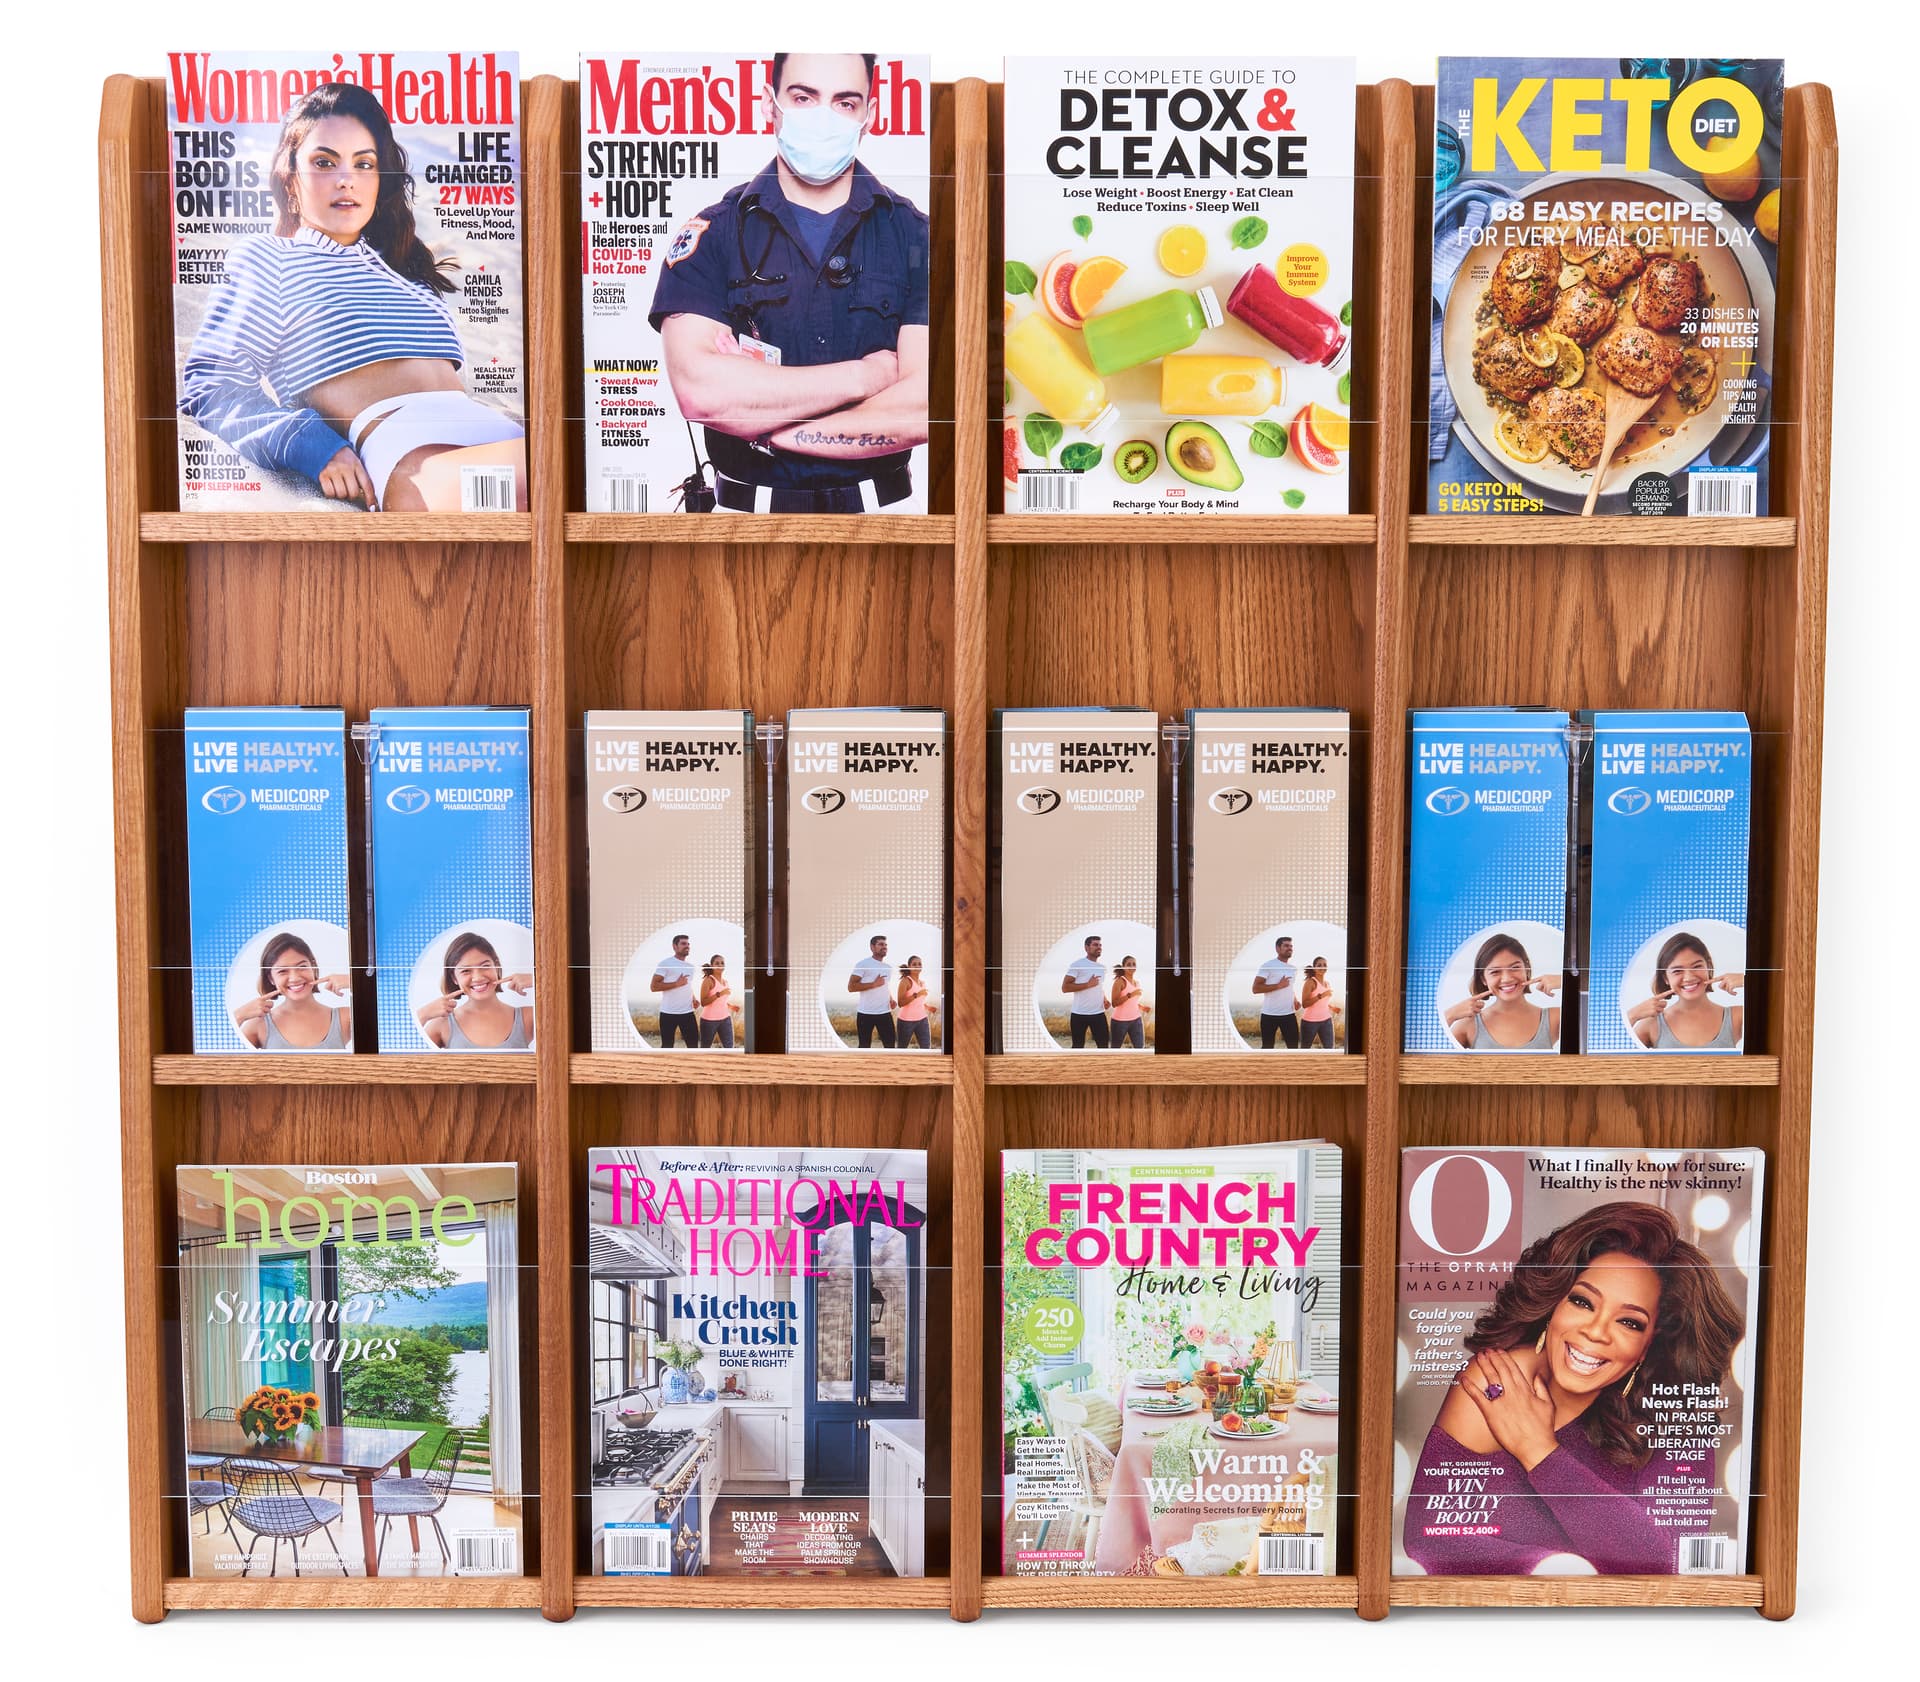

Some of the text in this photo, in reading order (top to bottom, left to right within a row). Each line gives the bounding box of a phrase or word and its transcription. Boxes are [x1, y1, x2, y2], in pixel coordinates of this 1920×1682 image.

[1064, 70, 1296, 84] THE COMPLETE GUIDE TO
[586, 60, 736, 136] Men's
[1060, 88, 1296, 132] DETOX &
[1458, 108, 1471, 138] THE
[1472, 77, 1764, 174] KETO
[1695, 118, 1736, 134] DIET
[174, 130, 235, 158] THIS
[458, 132, 514, 163] LIFE.
[588, 141, 718, 179] STRENGTH
[1046, 136, 1308, 180] CLEANSE
[176, 160, 260, 188] BOD IS
[425, 165, 515, 184] CHANGED.
[439, 186, 515, 205] 27 WAYS
[1063, 188, 1294, 202] Lose Weight Boost Energy Eat Clean
[177, 190, 274, 218] ON FIRE
[1490, 202, 1723, 222] 68 EASY RECIPES
[178, 223, 272, 234] SAME WORKOUT
[1458, 226, 1756, 247] FOR EVERY MEAL OF THE DAY
[592, 248, 651, 260] COVID-19
[592, 262, 647, 274] Hot Zone
[465, 274, 501, 286] CAMILA
[464, 286, 503, 297] MENDES
[1680, 322, 1759, 334] 20 MINUTES
[594, 360, 658, 372] WHAT NOW?
[601, 429, 641, 438] FITNESS
[601, 438, 650, 447] BLOWOUT
[193, 742, 340, 756] LIVE HEALTHY.
[379, 742, 524, 756] LIVE HEALTHY.
[595, 741, 742, 755] LIVE HEALTHY.
[794, 742, 940, 756] LIVE HEALTHY.
[1009, 742, 1156, 756] LIVE HEALTHY.
[1202, 743, 1348, 757] LIVE HEALTHY.
[1420, 743, 1563, 757] LIVE HEALTHY.
[1602, 744, 1746, 758] LIVE HEALTHY.
[193, 759, 318, 773] LIVE HAPPY.
[378, 759, 502, 773] LIVE HAPPY.
[595, 758, 720, 772] LIVE HAPPY.
[794, 759, 918, 773] LIVE HAPPY.
[1009, 759, 1134, 773] LIVE HAPPY.
[1202, 760, 1325, 773] LIVE HAPPY.
[1419, 760, 1542, 774] LIVE HAPPY.
[1602, 760, 1724, 774] LIVE HAPPY.
[251, 788, 329, 803] MEDICORP
[435, 788, 513, 803] MEDICORP
[652, 788, 731, 802] MEDICORP
[850, 789, 929, 803] MEDICORP
[1066, 789, 1144, 804] MEDICORP
[1258, 789, 1336, 804] MEDICORP
[1474, 789, 1552, 803] MEDICORP
[1656, 789, 1734, 803] MEDICORP
[1528, 1158, 1746, 1175] What I finally know for sure:
[306, 1171, 378, 1185] Boston
[1540, 1176, 1742, 1193] Healthy is the new skinny!
[596, 1164, 922, 1228] TRADITIONAL
[1049, 1182, 1296, 1224] FRENCH
[212, 1172, 477, 1249] home
[1408, 1154, 1512, 1256] O
[690, 1228, 830, 1277] HOME
[1024, 1227, 1321, 1270] COUNTRY
[1408, 1261, 1513, 1272] THE OPRAH
[1117, 1256, 1325, 1313] Home & Living
[207, 1290, 385, 1324] Summer
[672, 1294, 798, 1320] Kitchen
[1034, 1308, 1074, 1328] 250
[698, 1320, 799, 1346] Crush
[238, 1328, 401, 1373] Escapes
[719, 1349, 794, 1358] BLUE & WHITE
[719, 1359, 787, 1368] DONE RIGHT!
[1189, 1449, 1325, 1474] Warm &
[1142, 1475, 1325, 1510] Welcoming
[1447, 1479, 1488, 1493] WIN
[1425, 1495, 1503, 1510] BEAUTY
[731, 1512, 778, 1522] PRIME
[799, 1512, 859, 1522] MODERN
[1154, 1507, 1200, 1515] Decorating
[1252, 1507, 1276, 1515] Every
[1435, 1511, 1495, 1524] BOOTY
[733, 1522, 776, 1533] SEATS
[812, 1522, 848, 1533] LOVE
